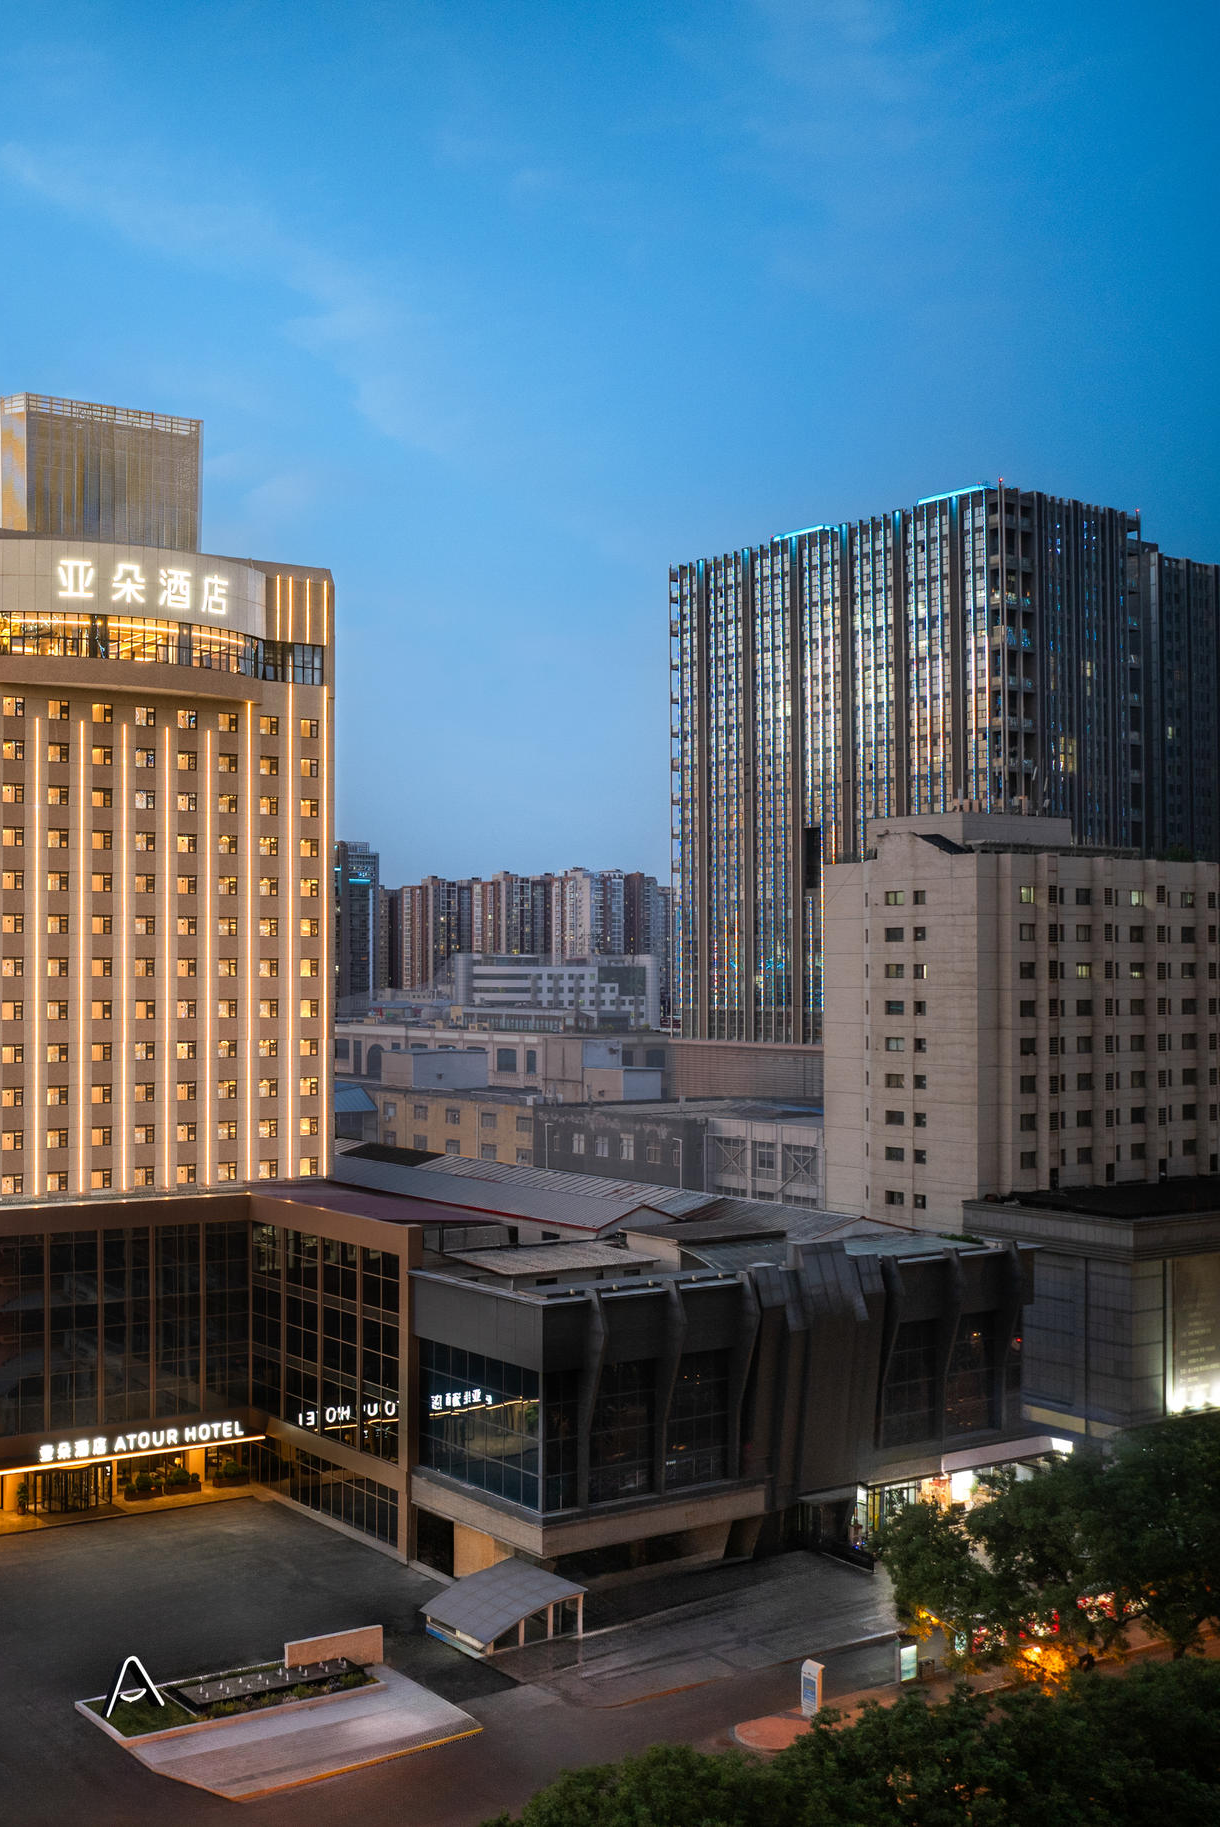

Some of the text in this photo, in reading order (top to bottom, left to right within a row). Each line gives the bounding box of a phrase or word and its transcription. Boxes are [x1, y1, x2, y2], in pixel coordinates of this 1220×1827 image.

[58, 559, 229, 615] 亚朵酒店
[39, 1420, 245, 1463] 亚朵酒店 ATOUR HOTEL
